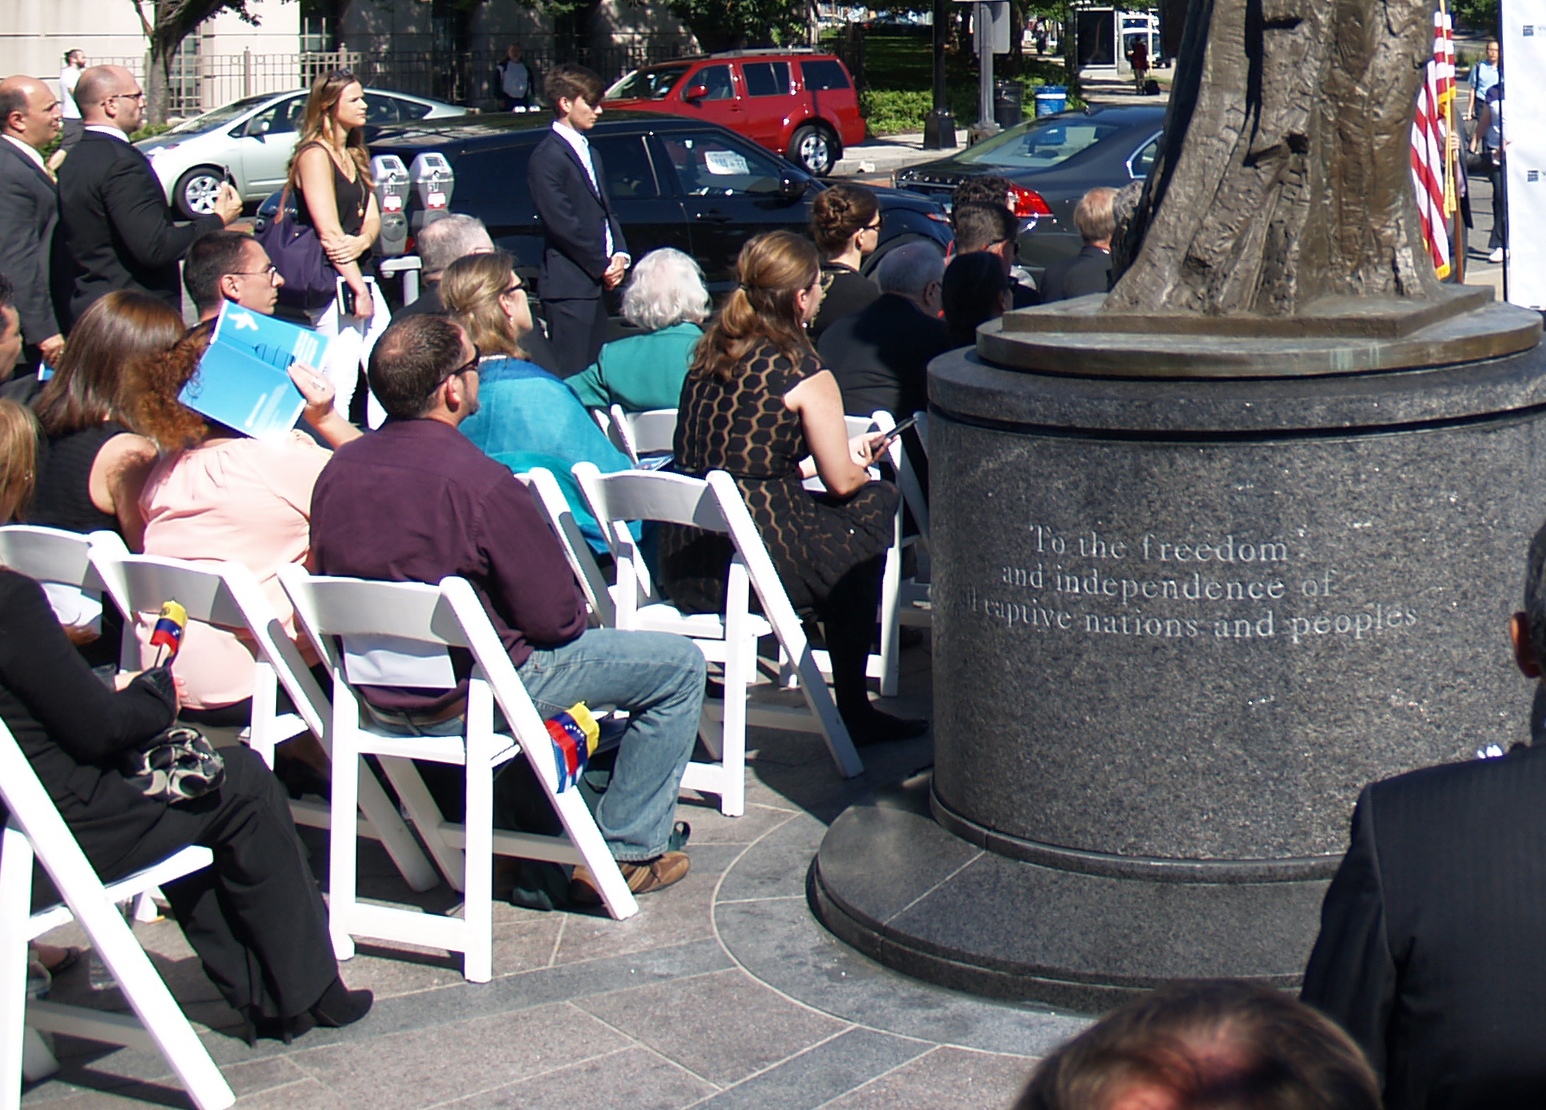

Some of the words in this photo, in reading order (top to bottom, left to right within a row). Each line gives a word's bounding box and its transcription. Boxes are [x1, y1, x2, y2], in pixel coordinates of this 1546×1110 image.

[1029, 524, 1066, 554] To
[1079, 531, 1127, 559] the
[1142, 533, 1289, 563] freedom
[1002, 563, 1044, 589] and
[1056, 564, 1286, 606] independence
[1301, 568, 1338, 598] of
[984, 597, 1072, 630] captive
[1086, 607, 1198, 638] nations
[1214, 609, 1276, 638] and
[1289, 603, 1418, 645] peoples
